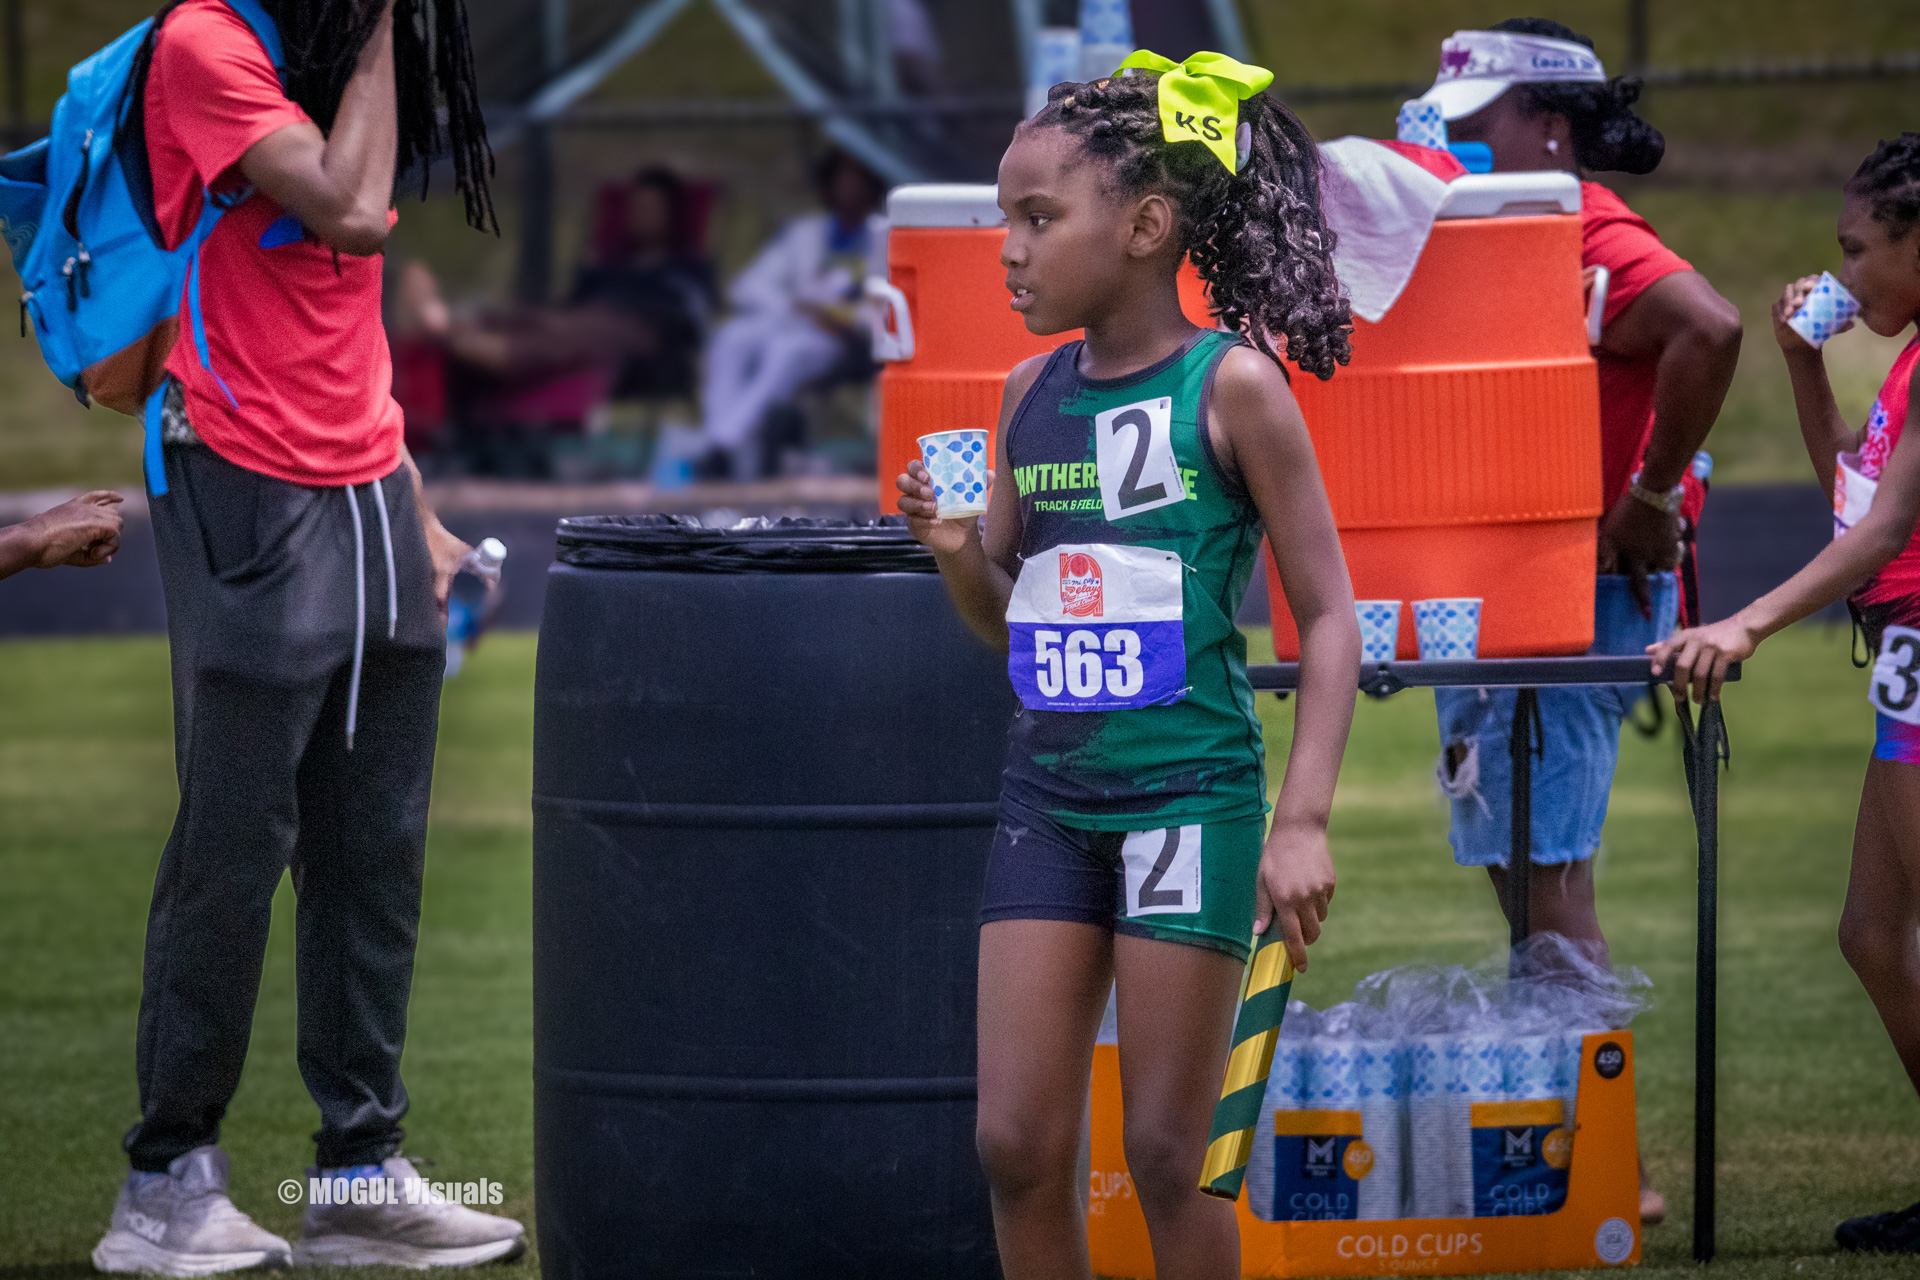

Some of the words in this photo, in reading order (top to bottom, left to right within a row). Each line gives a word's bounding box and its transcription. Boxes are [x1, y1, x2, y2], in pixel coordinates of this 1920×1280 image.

[1175, 111, 1222, 141] KS
[1111, 408, 1168, 511] 2
[1034, 501, 1069, 512] TRACK
[1034, 629, 1144, 698] 563
[1878, 634, 1920, 712] 3
[1138, 826, 1183, 909] 2
[1598, 1050, 1622, 1065] 450
[1289, 1192, 1349, 1211] COLD
[1489, 1183, 1550, 1201] COLD
[1337, 1234, 1409, 1258] COLD
[1416, 1232, 1483, 1256] CUPS
